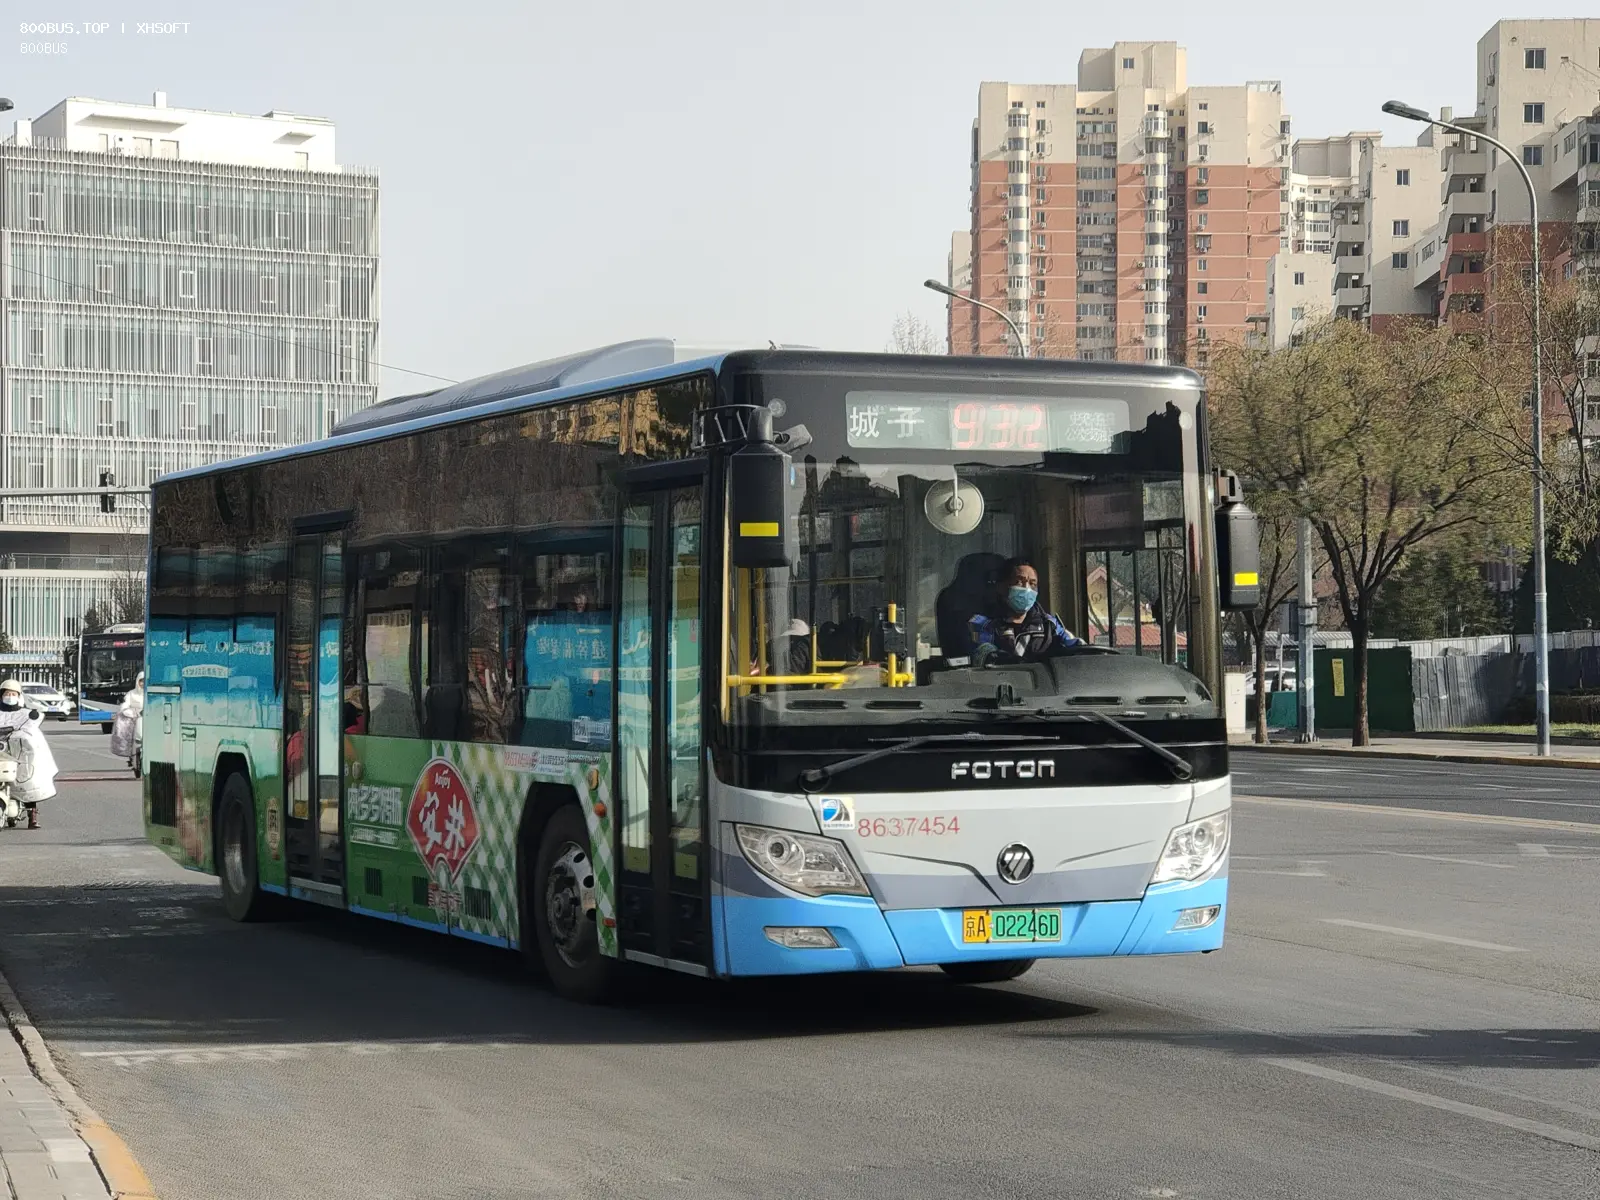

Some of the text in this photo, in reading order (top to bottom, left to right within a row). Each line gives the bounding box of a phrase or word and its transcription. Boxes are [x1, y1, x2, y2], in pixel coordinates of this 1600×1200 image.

[953, 403, 1043, 449] 932
[858, 816, 960, 838] 8637454
[965, 914, 1059, 938] 京A 02246D
